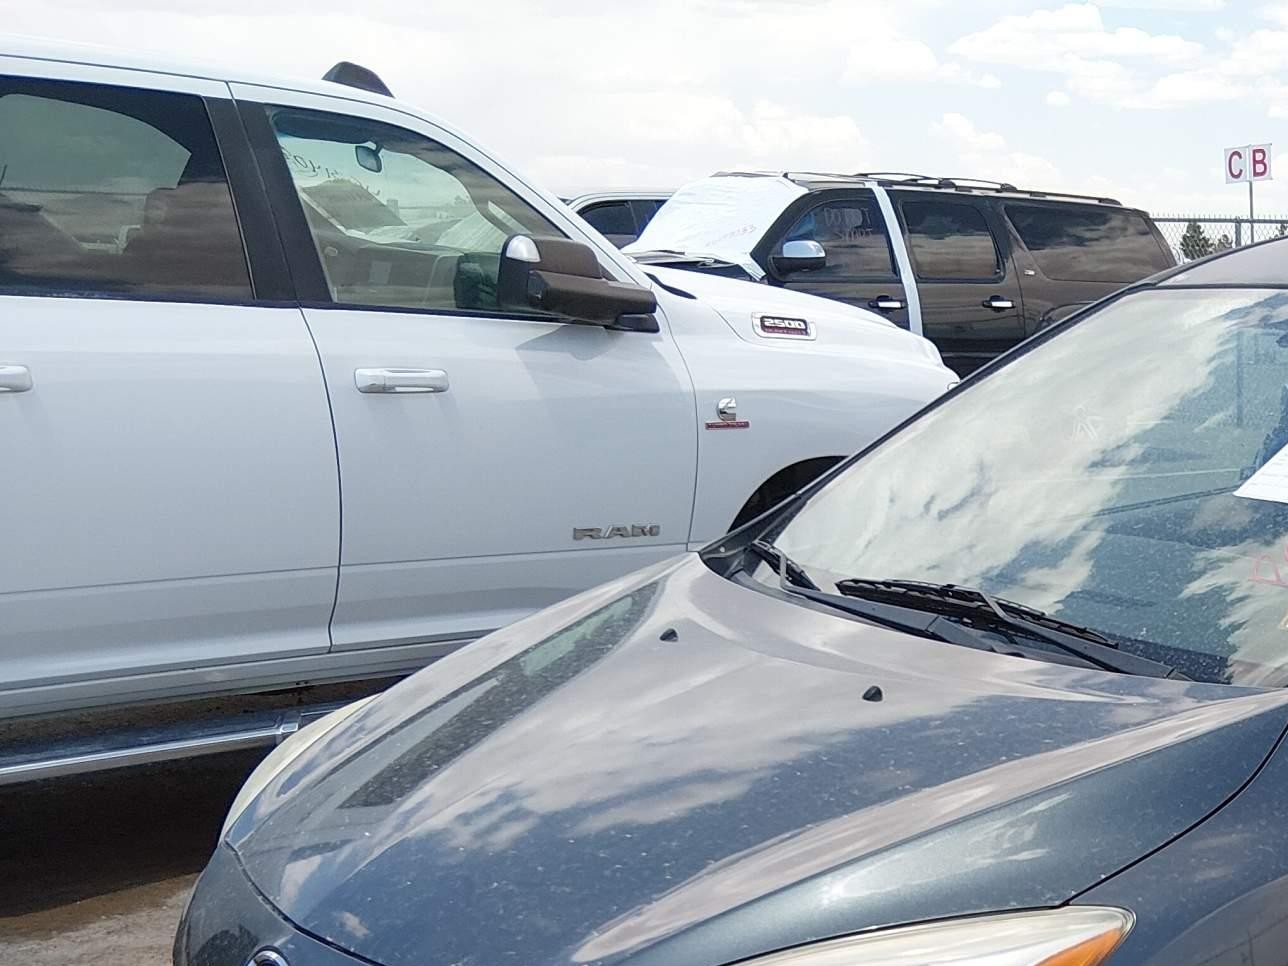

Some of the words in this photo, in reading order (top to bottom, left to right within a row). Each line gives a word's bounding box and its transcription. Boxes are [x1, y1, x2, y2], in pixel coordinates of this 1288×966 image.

[1228, 150, 1243, 179] C
[1252, 148, 1267, 177] B
[763, 318, 806, 329] 2500
[573, 524, 660, 540] RAM
